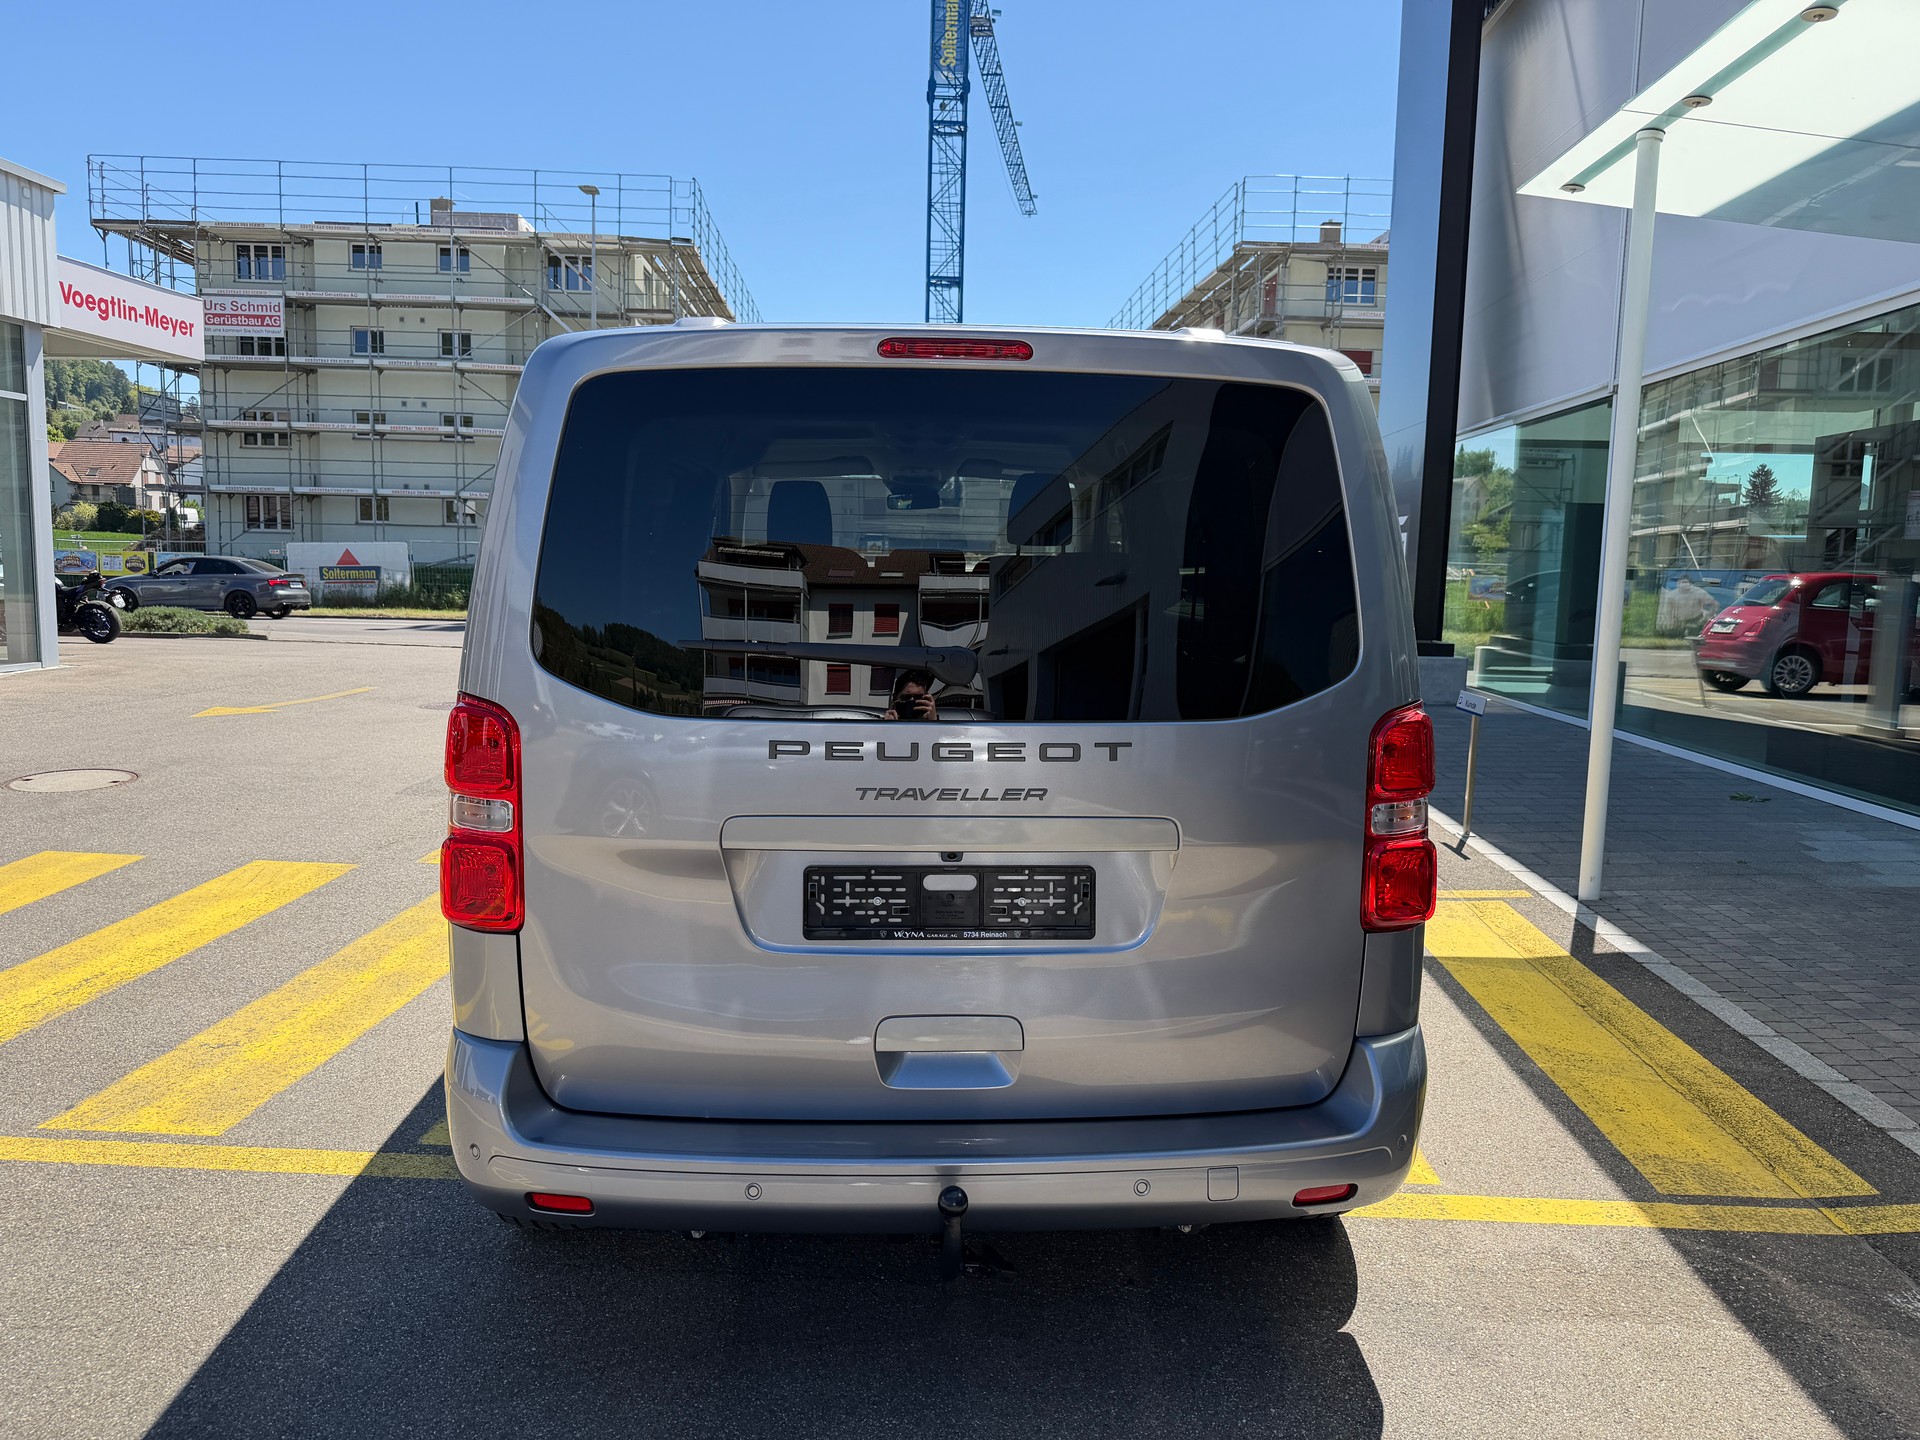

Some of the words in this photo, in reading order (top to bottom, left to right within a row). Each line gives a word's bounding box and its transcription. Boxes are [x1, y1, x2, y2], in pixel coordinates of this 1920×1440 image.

[940, 0, 959, 67] Solterma
[58, 280, 195, 338] Voegtlin-Meyer
[204, 299, 227, 311] Urs
[230, 300, 281, 313] Schmid
[205, 314, 262, 326] Gerüstbau
[263, 316, 280, 326] AG
[322, 567, 377, 580] Soltermann
[768, 739, 1133, 762] PEUGEOT
[855, 787, 1049, 802] TRAVELLER
